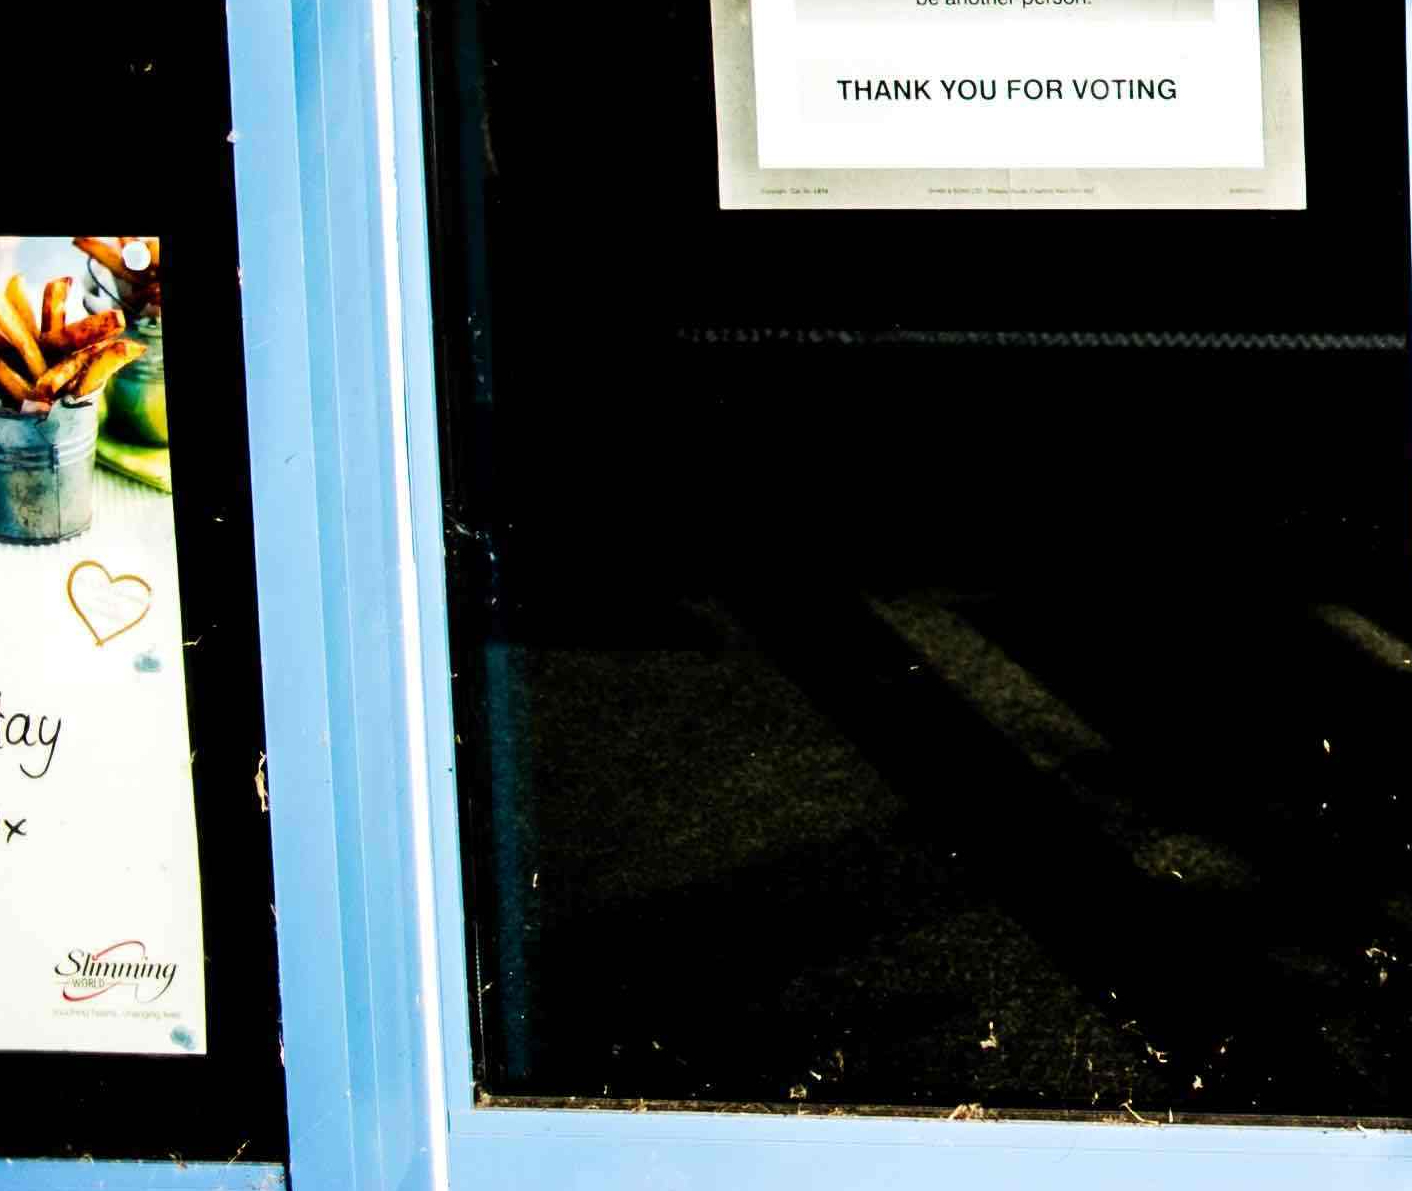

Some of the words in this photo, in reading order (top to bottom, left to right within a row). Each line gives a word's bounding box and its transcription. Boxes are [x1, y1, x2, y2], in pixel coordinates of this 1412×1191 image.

[837, 79, 932, 101] THANK
[940, 79, 996, 100] YOU
[1008, 79, 1063, 100] FOR
[1073, 78, 1177, 100] VOTING
[0, 691, 61, 778] ay
[54, 948, 176, 1003] Slimming
